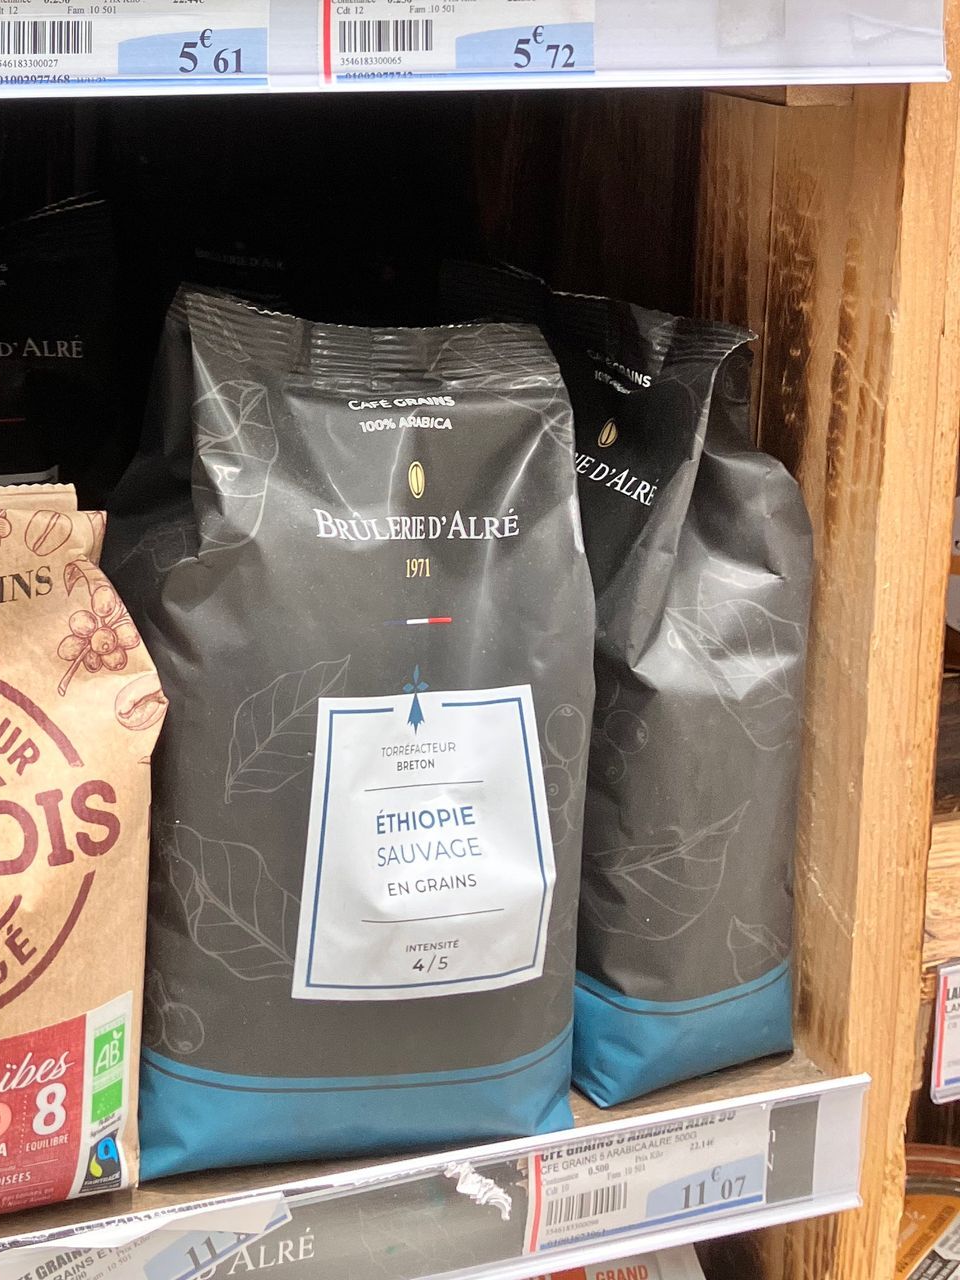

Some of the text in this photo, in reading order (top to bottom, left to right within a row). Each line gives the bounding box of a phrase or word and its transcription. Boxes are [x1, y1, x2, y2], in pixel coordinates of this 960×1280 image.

[339, 56, 402, 66] 3546183300065
[347, 395, 456, 411] CAFÉ GRAINS
[359, 415, 452, 433] 100% ARABICA
[313, 507, 520, 541] BRÛLERIE D'ALRÉ
[405, 558, 431, 578] 1971
[381, 741, 457, 759] TORRÉFACTEUR
[396, 758, 435, 772] BRETON
[376, 805, 476, 835] ÉTHIOPIE
[377, 837, 482, 867] SAUVAGE
[387, 873, 477, 897] EN GRAINS
[405, 939, 460, 953] INTENSITÉ
[95, 1039, 121, 1075] AB
[32, 1082, 67, 1136] 8
[561, 1131, 698, 1172] GRAINS ARABICA ALRE 500G
